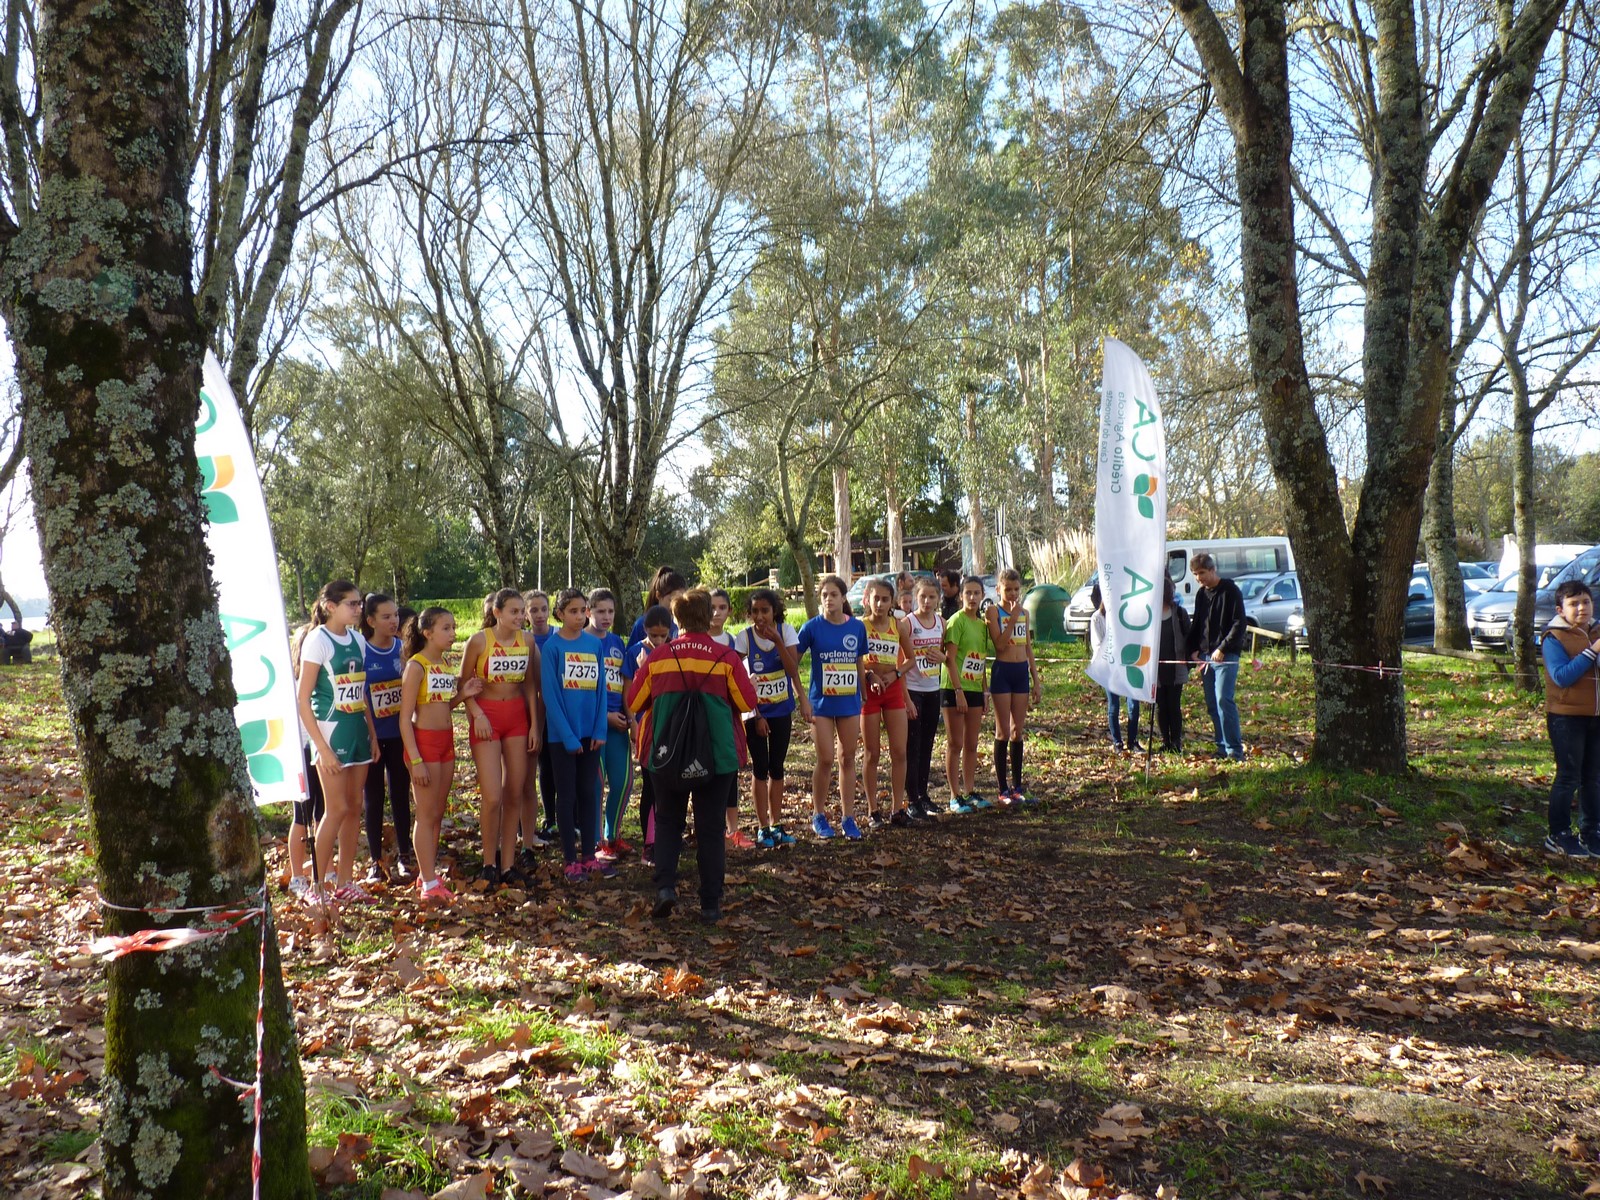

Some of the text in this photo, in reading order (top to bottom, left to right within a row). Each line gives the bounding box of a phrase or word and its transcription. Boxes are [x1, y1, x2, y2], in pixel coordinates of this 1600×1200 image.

[670, 642, 713, 654] PORTUGAL
[869, 642, 896, 654] 2991
[819, 650, 857, 660] cyclones
[493, 660, 526, 671] 2992
[568, 665, 597, 679] 7375
[826, 673, 854, 685] 7310
[758, 681, 786, 696] 7319
[681, 768, 709, 779] adidas
